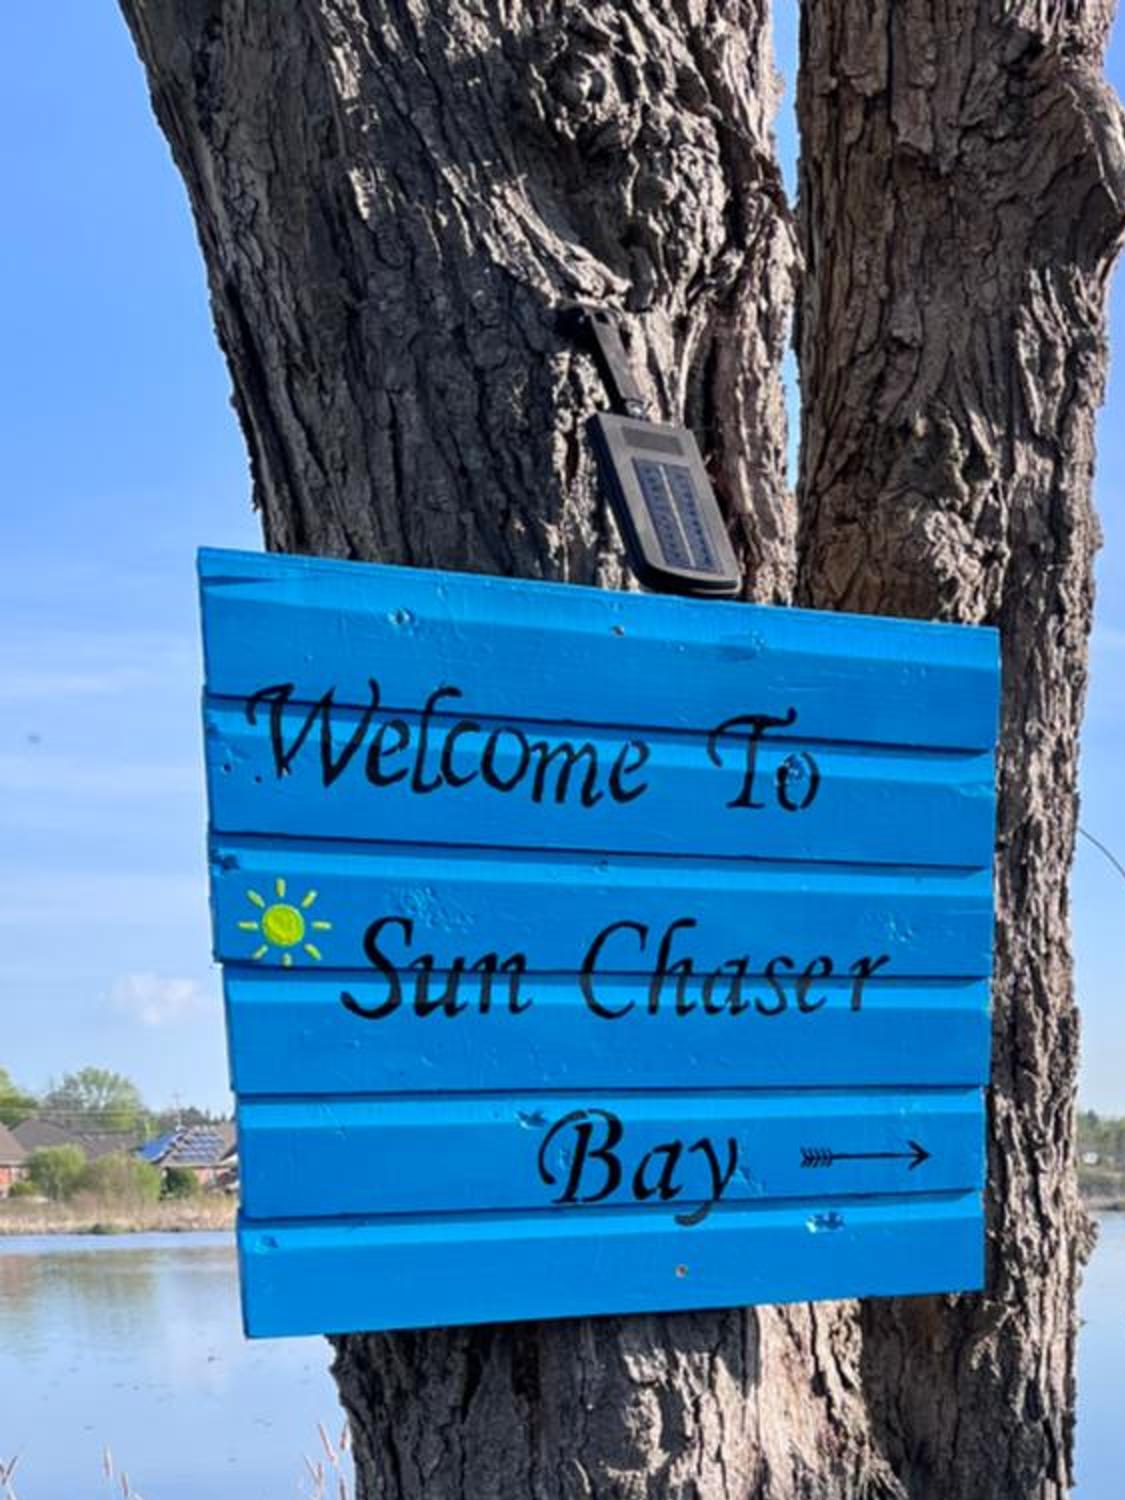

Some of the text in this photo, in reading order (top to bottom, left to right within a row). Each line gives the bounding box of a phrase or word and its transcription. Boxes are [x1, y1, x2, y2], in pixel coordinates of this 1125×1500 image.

[245, 678, 821, 812] Welcome To
[340, 915, 891, 1021] Sun Chaser
[537, 1108, 740, 1227] Bay
